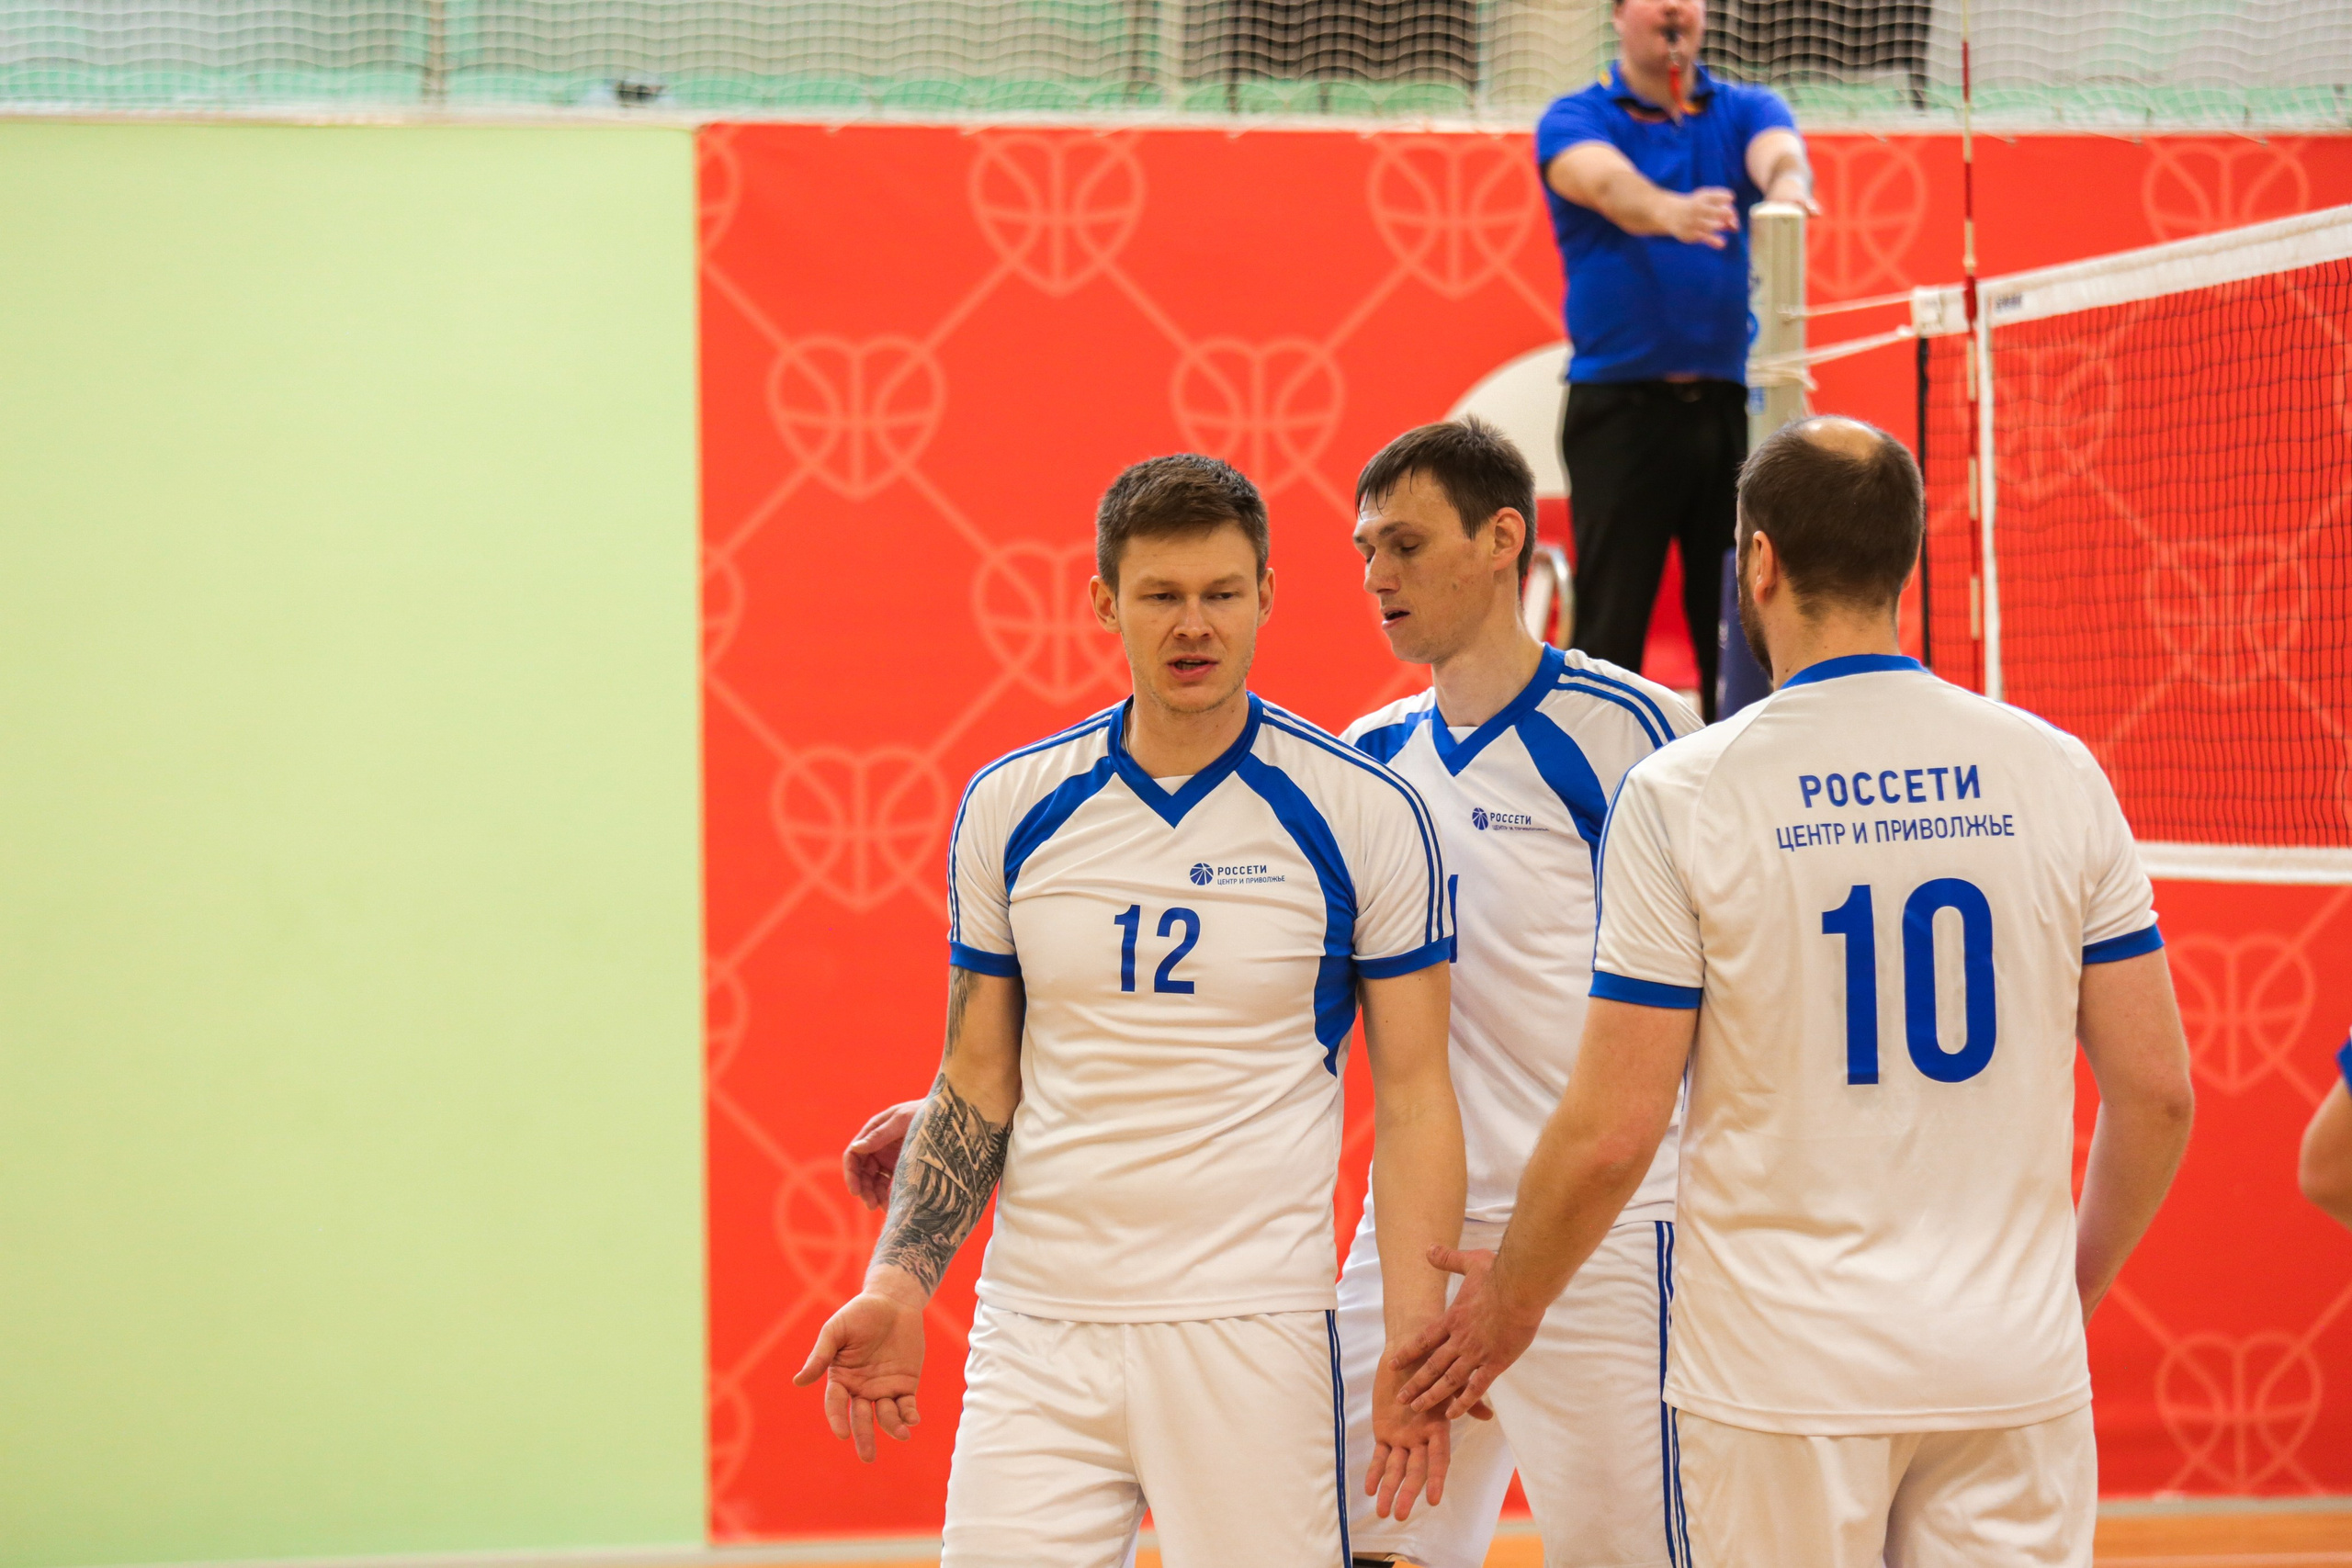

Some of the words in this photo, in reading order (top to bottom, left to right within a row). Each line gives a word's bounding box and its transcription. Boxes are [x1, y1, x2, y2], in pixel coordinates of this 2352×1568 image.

[1798, 764, 1981, 808] РОССЕТИ
[1490, 812, 1532, 825] РОССЕТИ
[1776, 823, 1846, 852] ЦЕНТР
[1852, 822, 1868, 844] И
[1874, 815, 2015, 843] ПРИВОЛЖЬЕ
[1217, 864, 1267, 875] РОССЕТИ
[1246, 875, 1285, 884] ПРИВОЛЖЬЕ
[1114, 904, 1201, 994] 12
[1822, 877, 1996, 1085] 10
